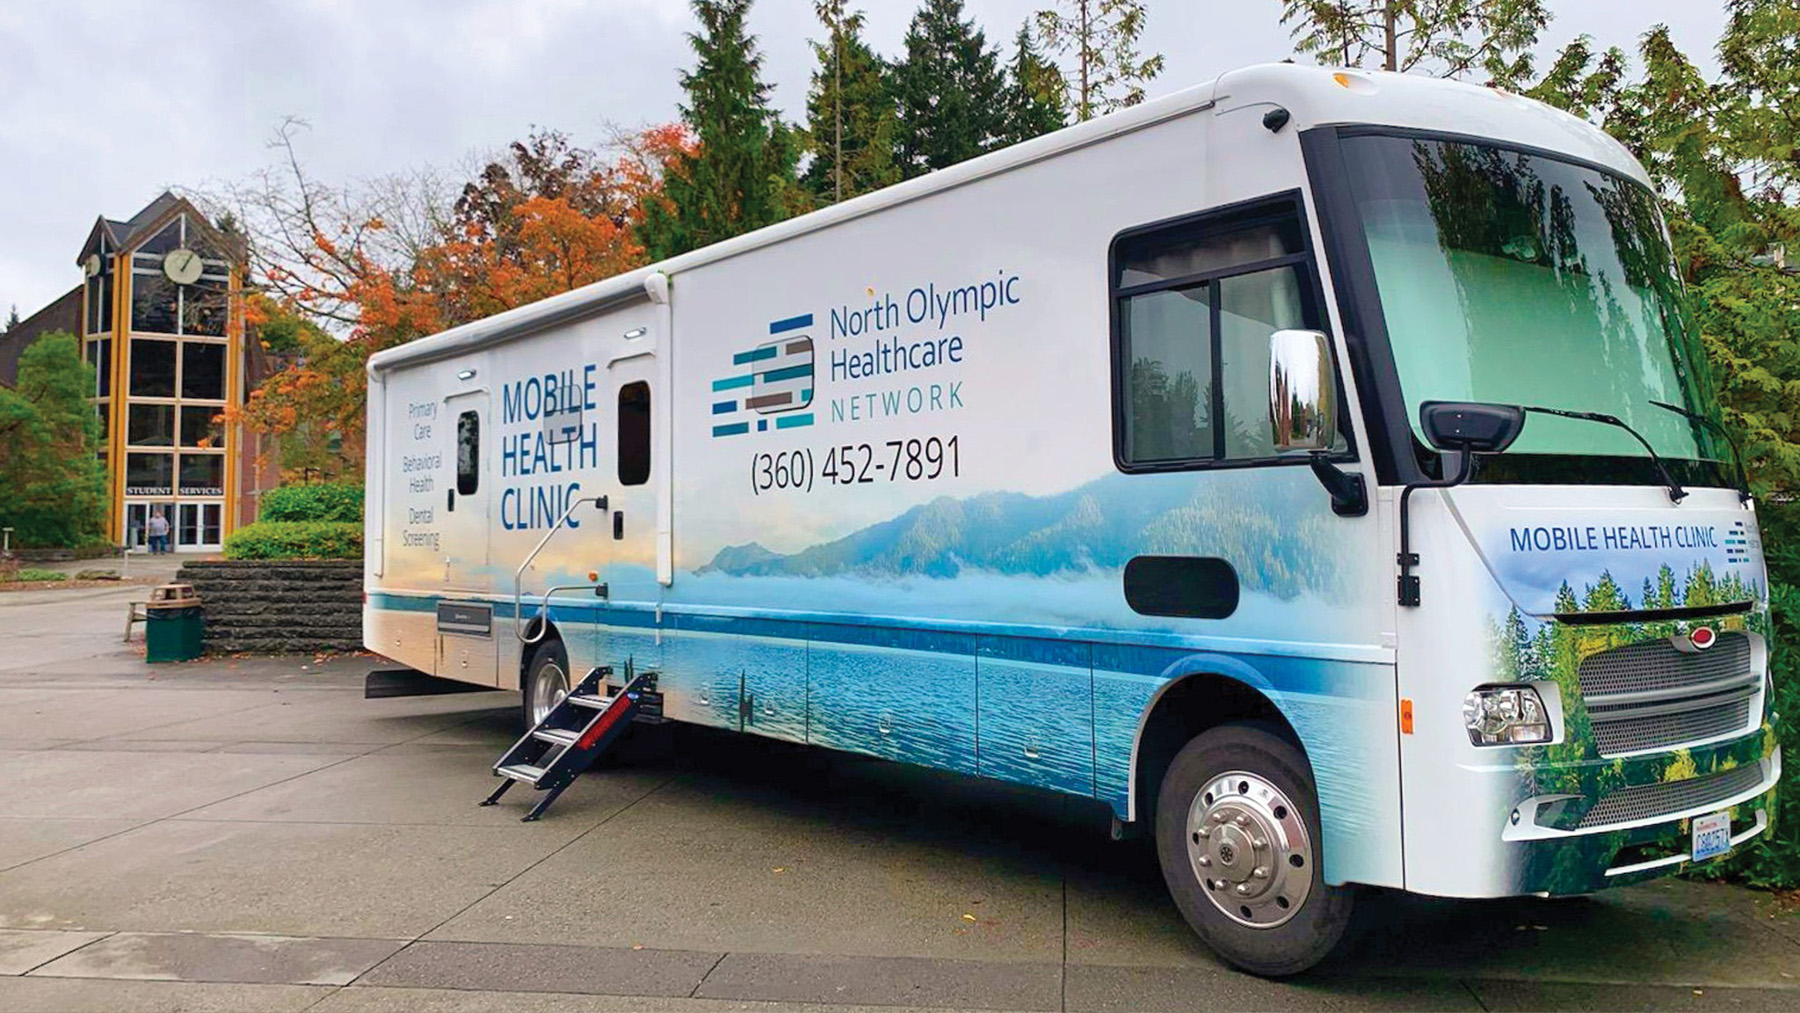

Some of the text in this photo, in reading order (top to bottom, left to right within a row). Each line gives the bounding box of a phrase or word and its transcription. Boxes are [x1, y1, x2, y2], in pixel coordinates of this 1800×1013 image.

[831, 270, 1020, 339] North Olympic
[831, 335, 963, 382] Healthcare
[503, 364, 596, 424] MOBILE
[831, 381, 963, 423] NETWORK
[408, 401, 438, 420] Primary
[414, 423, 431, 440] Care
[403, 451, 442, 472] Behavioral
[503, 422, 597, 477] HEALTH
[752, 435, 960, 495] (360) 452-7891
[127, 487, 222, 495] STUDENT SERVICES
[409, 475, 434, 493] Health
[409, 505, 433, 524] Dental
[501, 482, 581, 530] CLINIC
[403, 529, 440, 551] Screening
[1510, 527, 1598, 551] MOBILE
[1603, 526, 1672, 550] HEALTH
[1675, 526, 1718, 548] CLINIC
